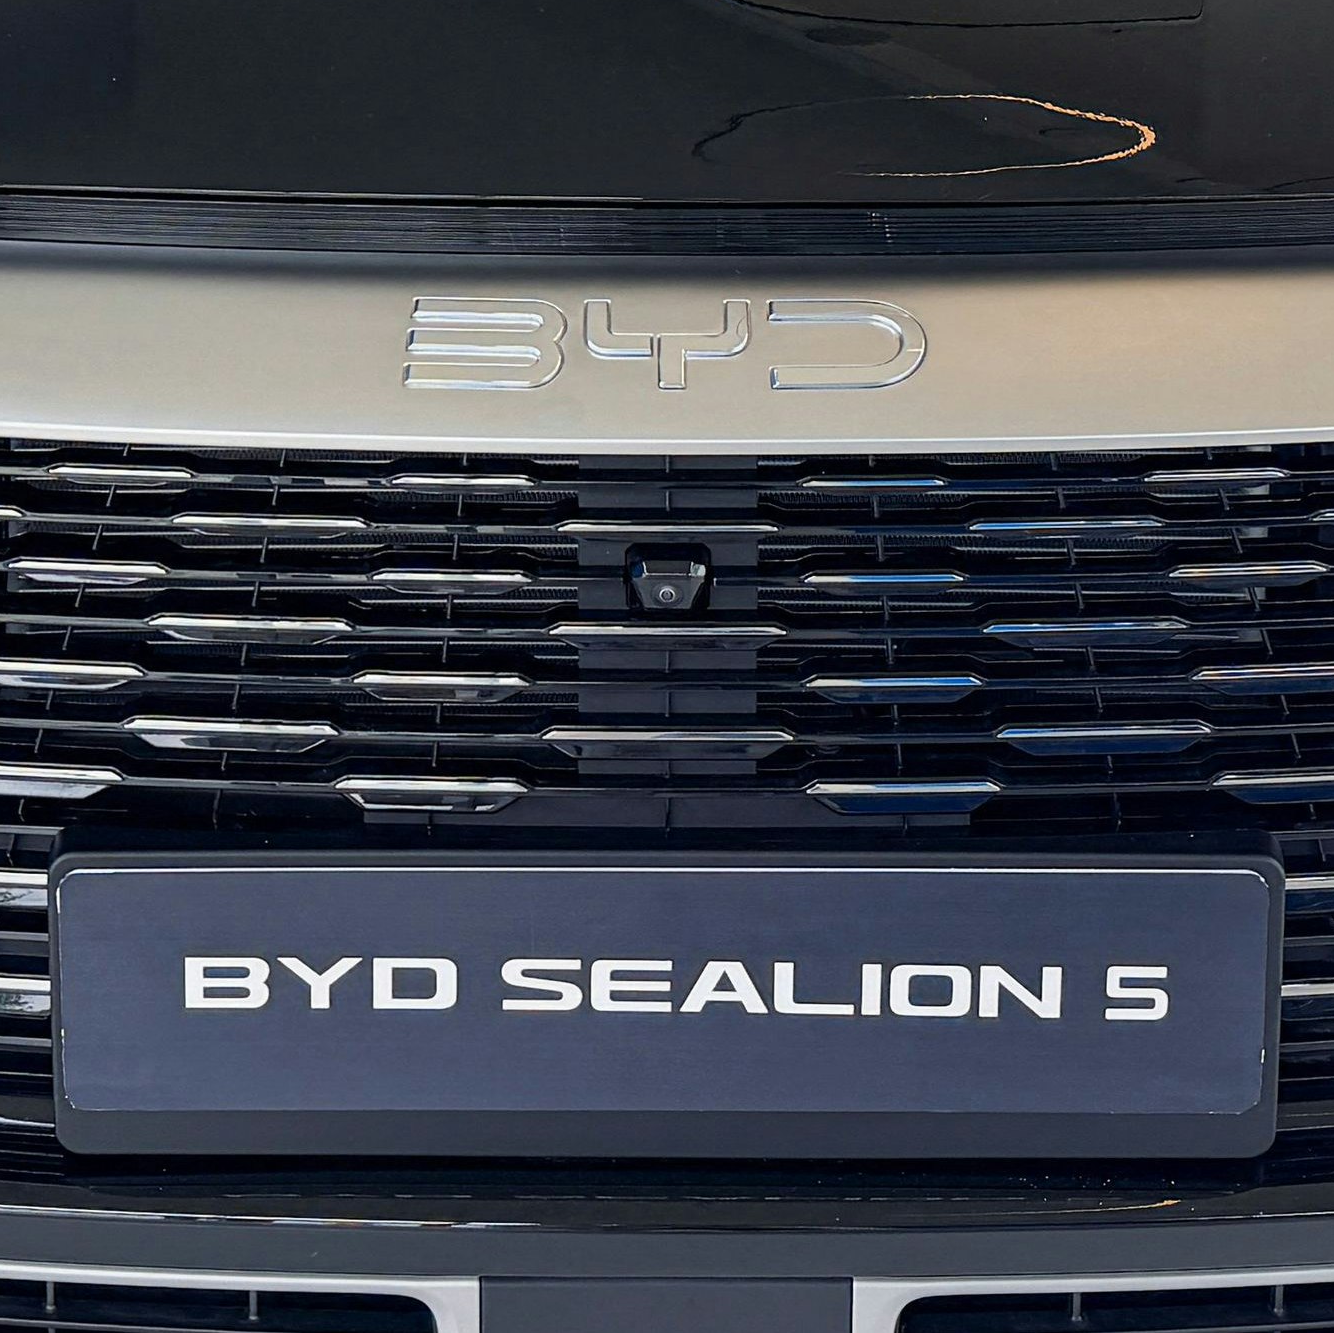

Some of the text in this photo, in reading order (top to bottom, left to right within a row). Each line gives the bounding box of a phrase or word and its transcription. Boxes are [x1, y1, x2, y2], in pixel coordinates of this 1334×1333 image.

[402, 296, 928, 390] BYD
[183, 955, 1171, 1022] BYD SEALION 5
